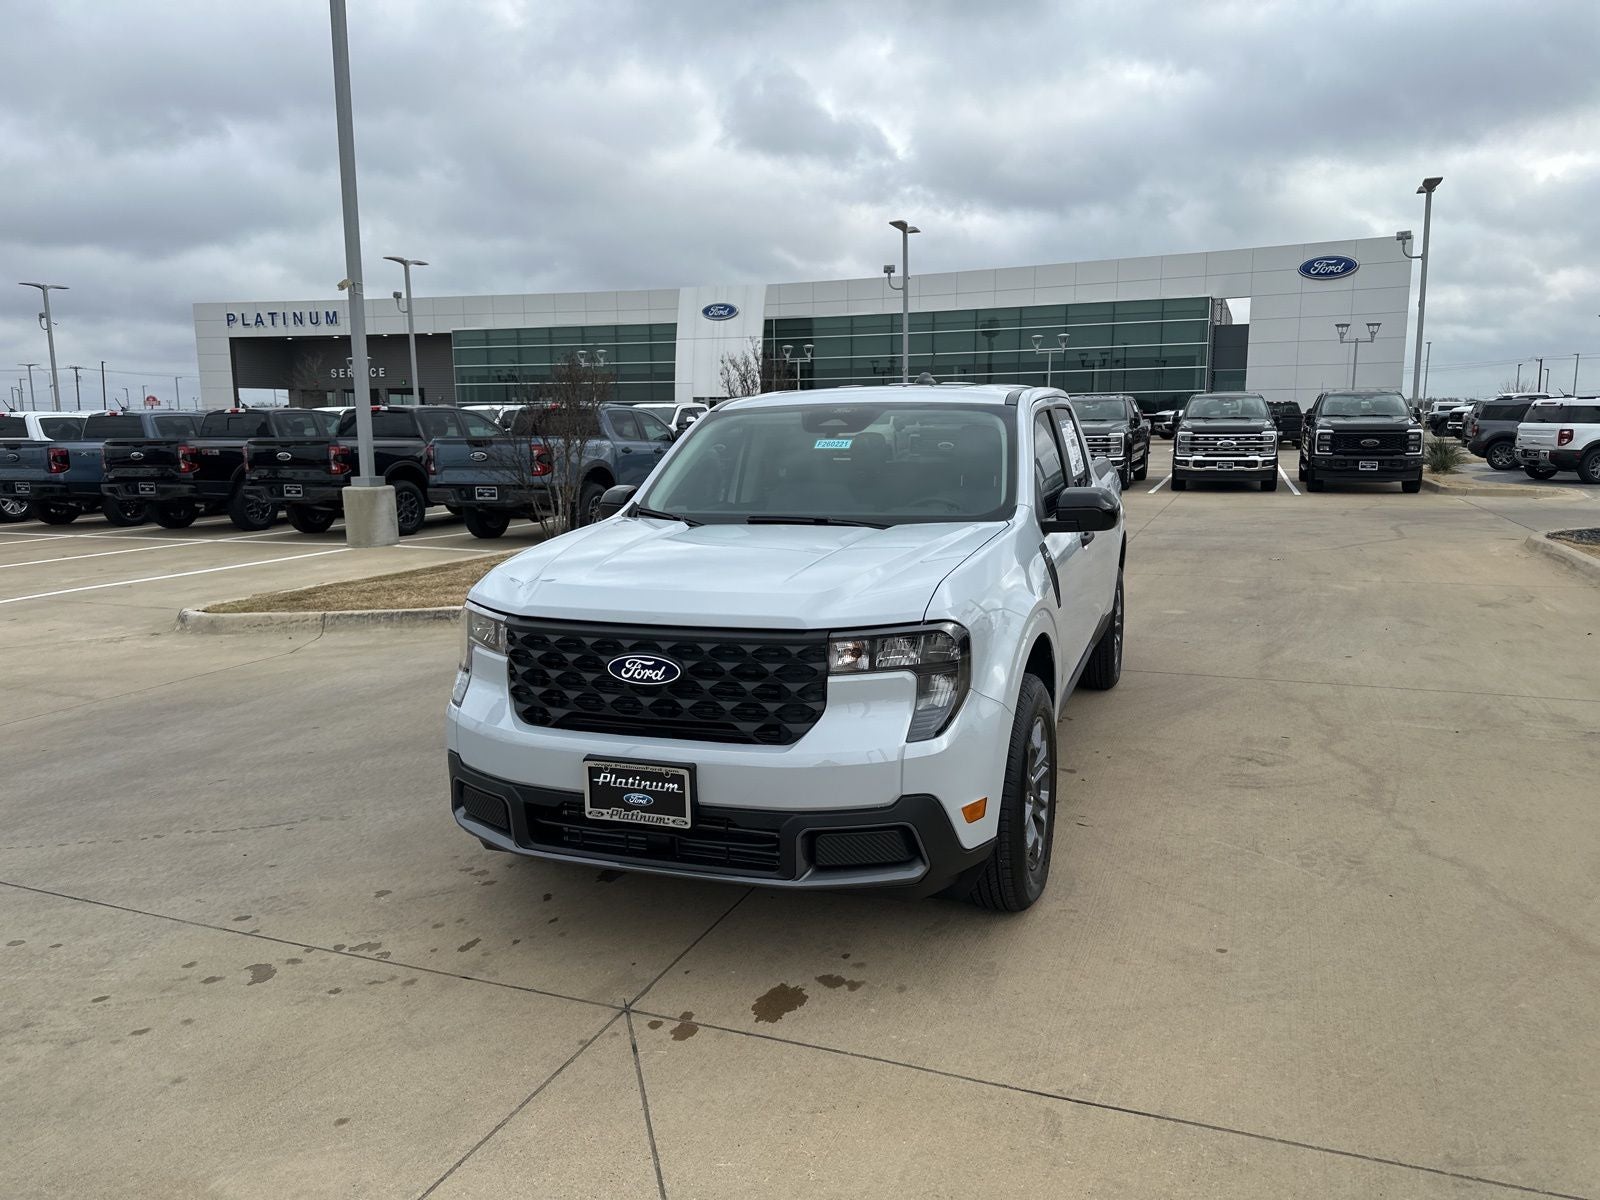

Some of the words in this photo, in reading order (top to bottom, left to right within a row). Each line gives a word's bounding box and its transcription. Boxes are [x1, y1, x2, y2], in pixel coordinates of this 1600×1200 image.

[226, 310, 339, 327] PLATINUM
[330, 367, 386, 378] SERCE
[621, 658, 666, 680] Ford
[593, 773, 684, 793] Platinum
[609, 808, 671, 825] Platinum
